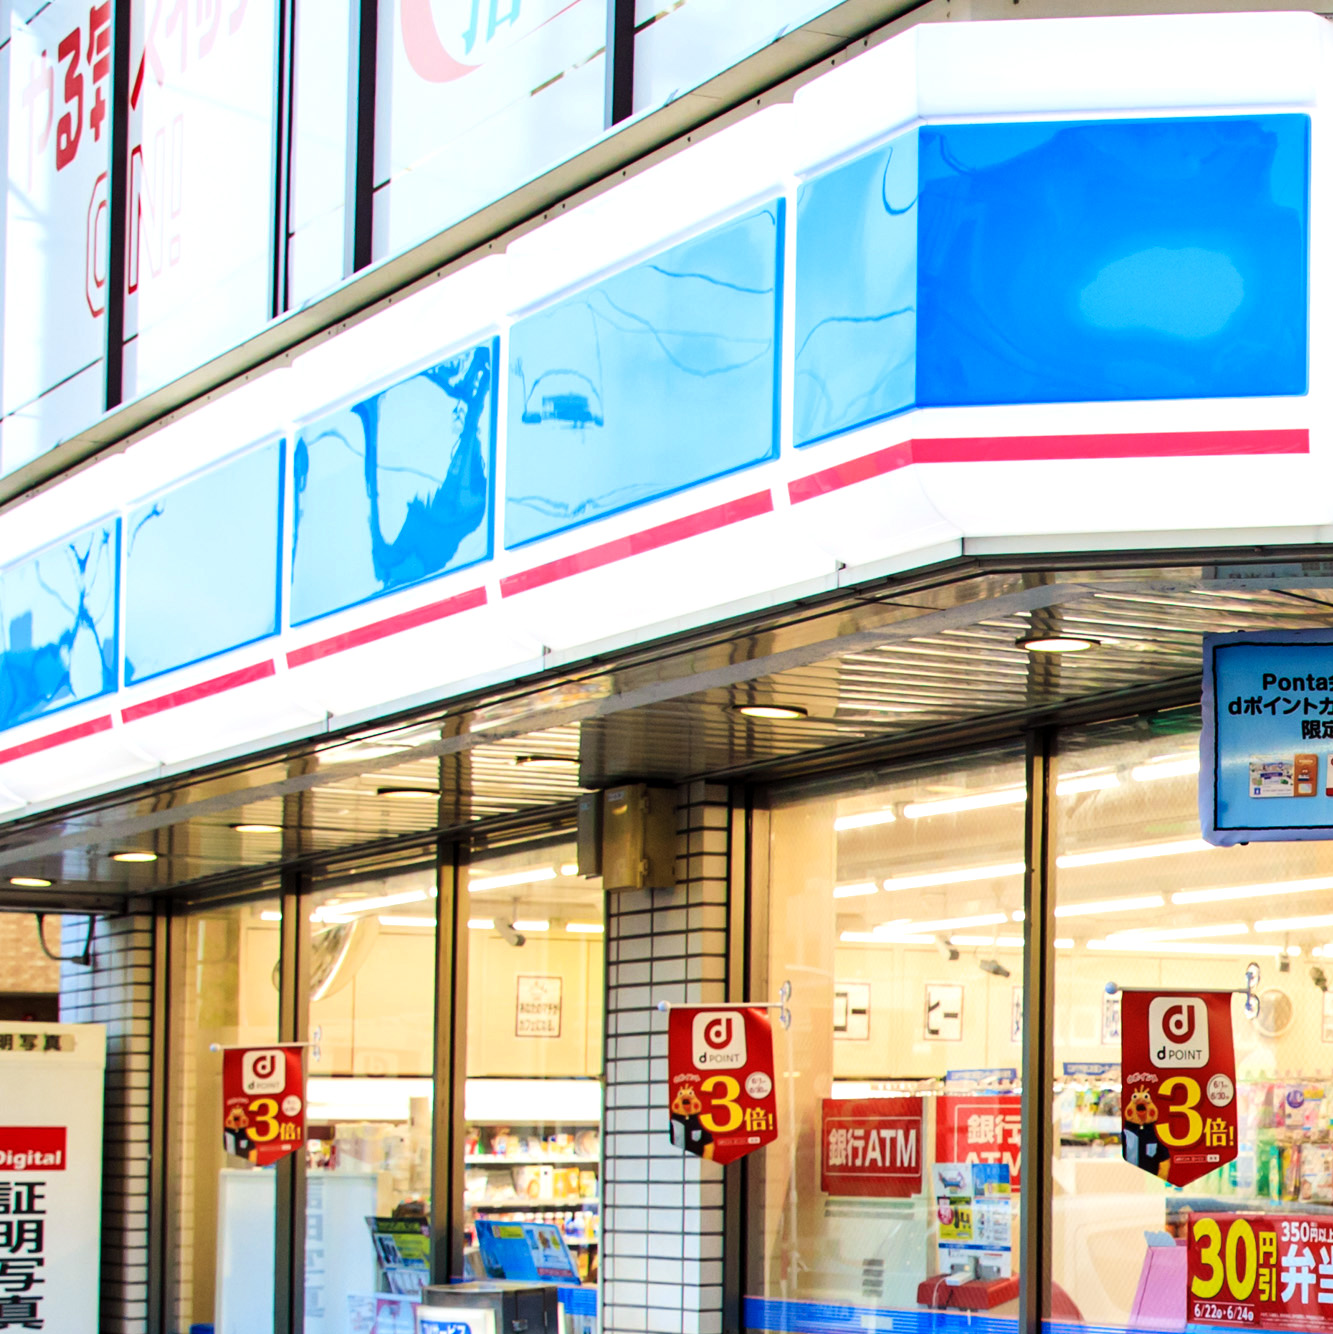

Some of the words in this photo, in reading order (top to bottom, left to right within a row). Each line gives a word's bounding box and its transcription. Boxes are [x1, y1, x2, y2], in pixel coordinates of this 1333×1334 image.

[709, 1053, 741, 1063] POINT
[1168, 1049, 1203, 1061] POINT
[967, 1114, 1021, 1145] 銀行
[828, 1128, 917, 1167] 銀行ATM
[0, 1181, 46, 1330] 証明写真
